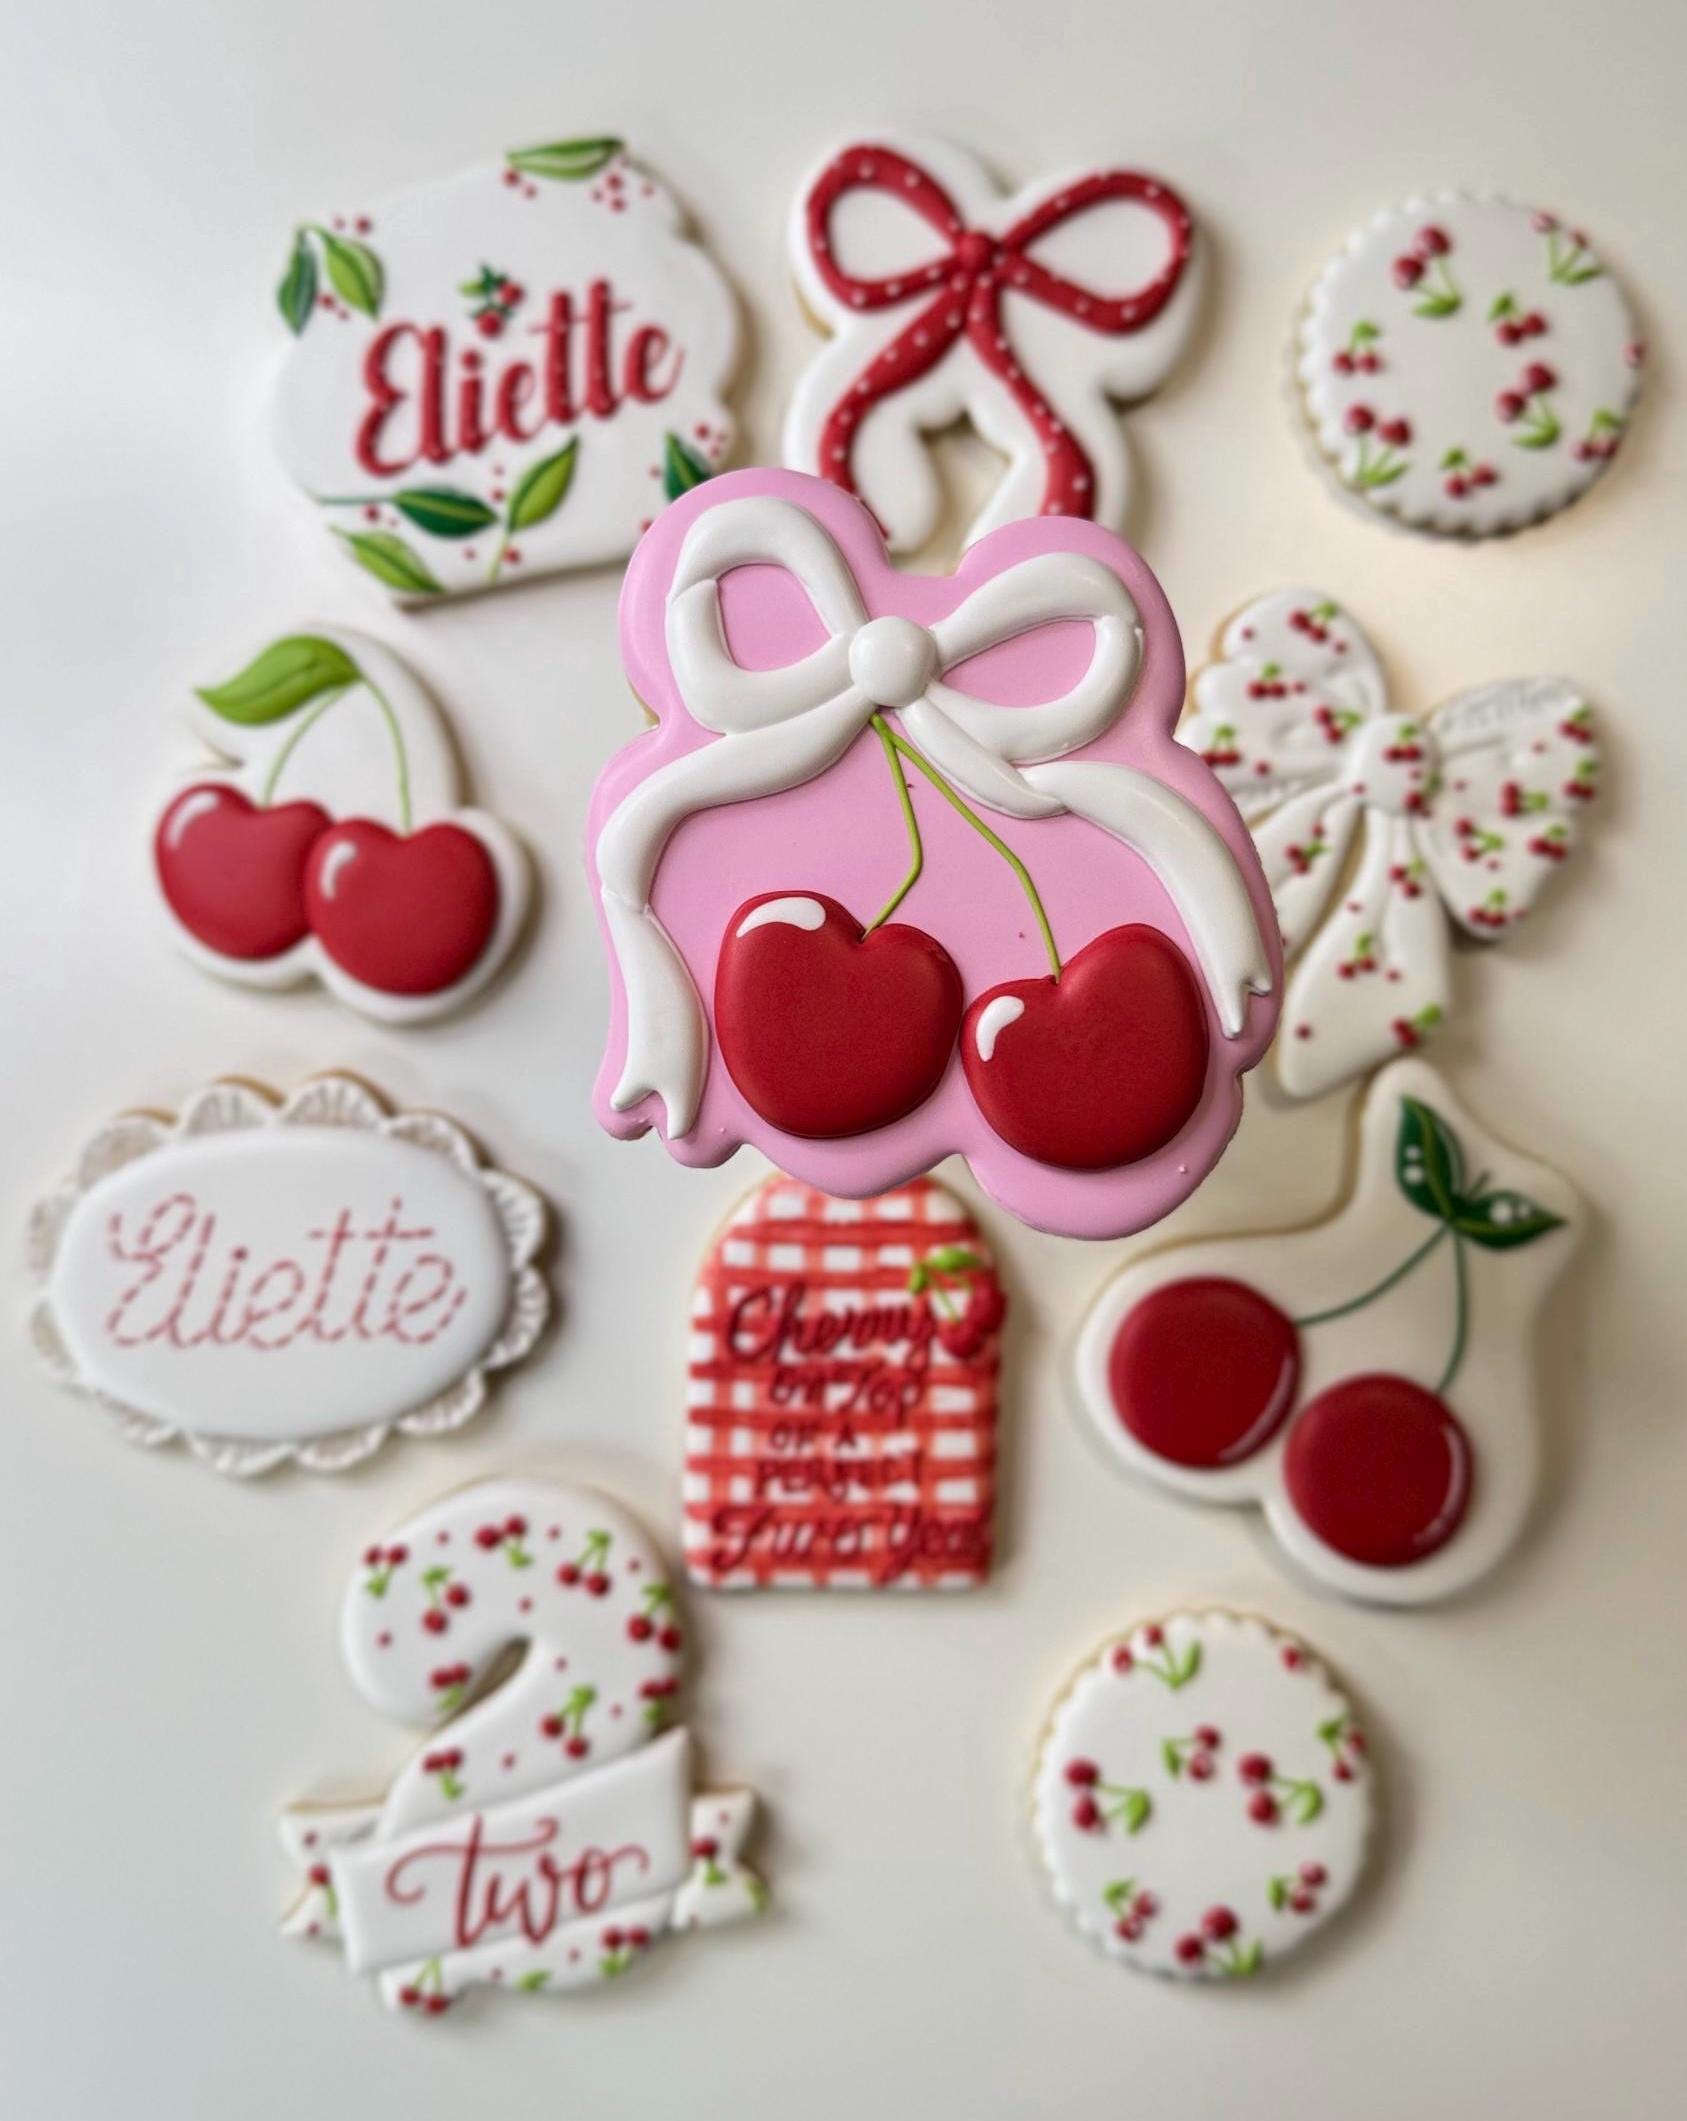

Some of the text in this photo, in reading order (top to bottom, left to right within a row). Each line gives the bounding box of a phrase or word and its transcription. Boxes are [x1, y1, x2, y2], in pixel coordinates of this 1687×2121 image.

[354, 276, 686, 479] Eliette
[106, 1193, 467, 1349] Eliette
[384, 1814, 650, 1948] two
